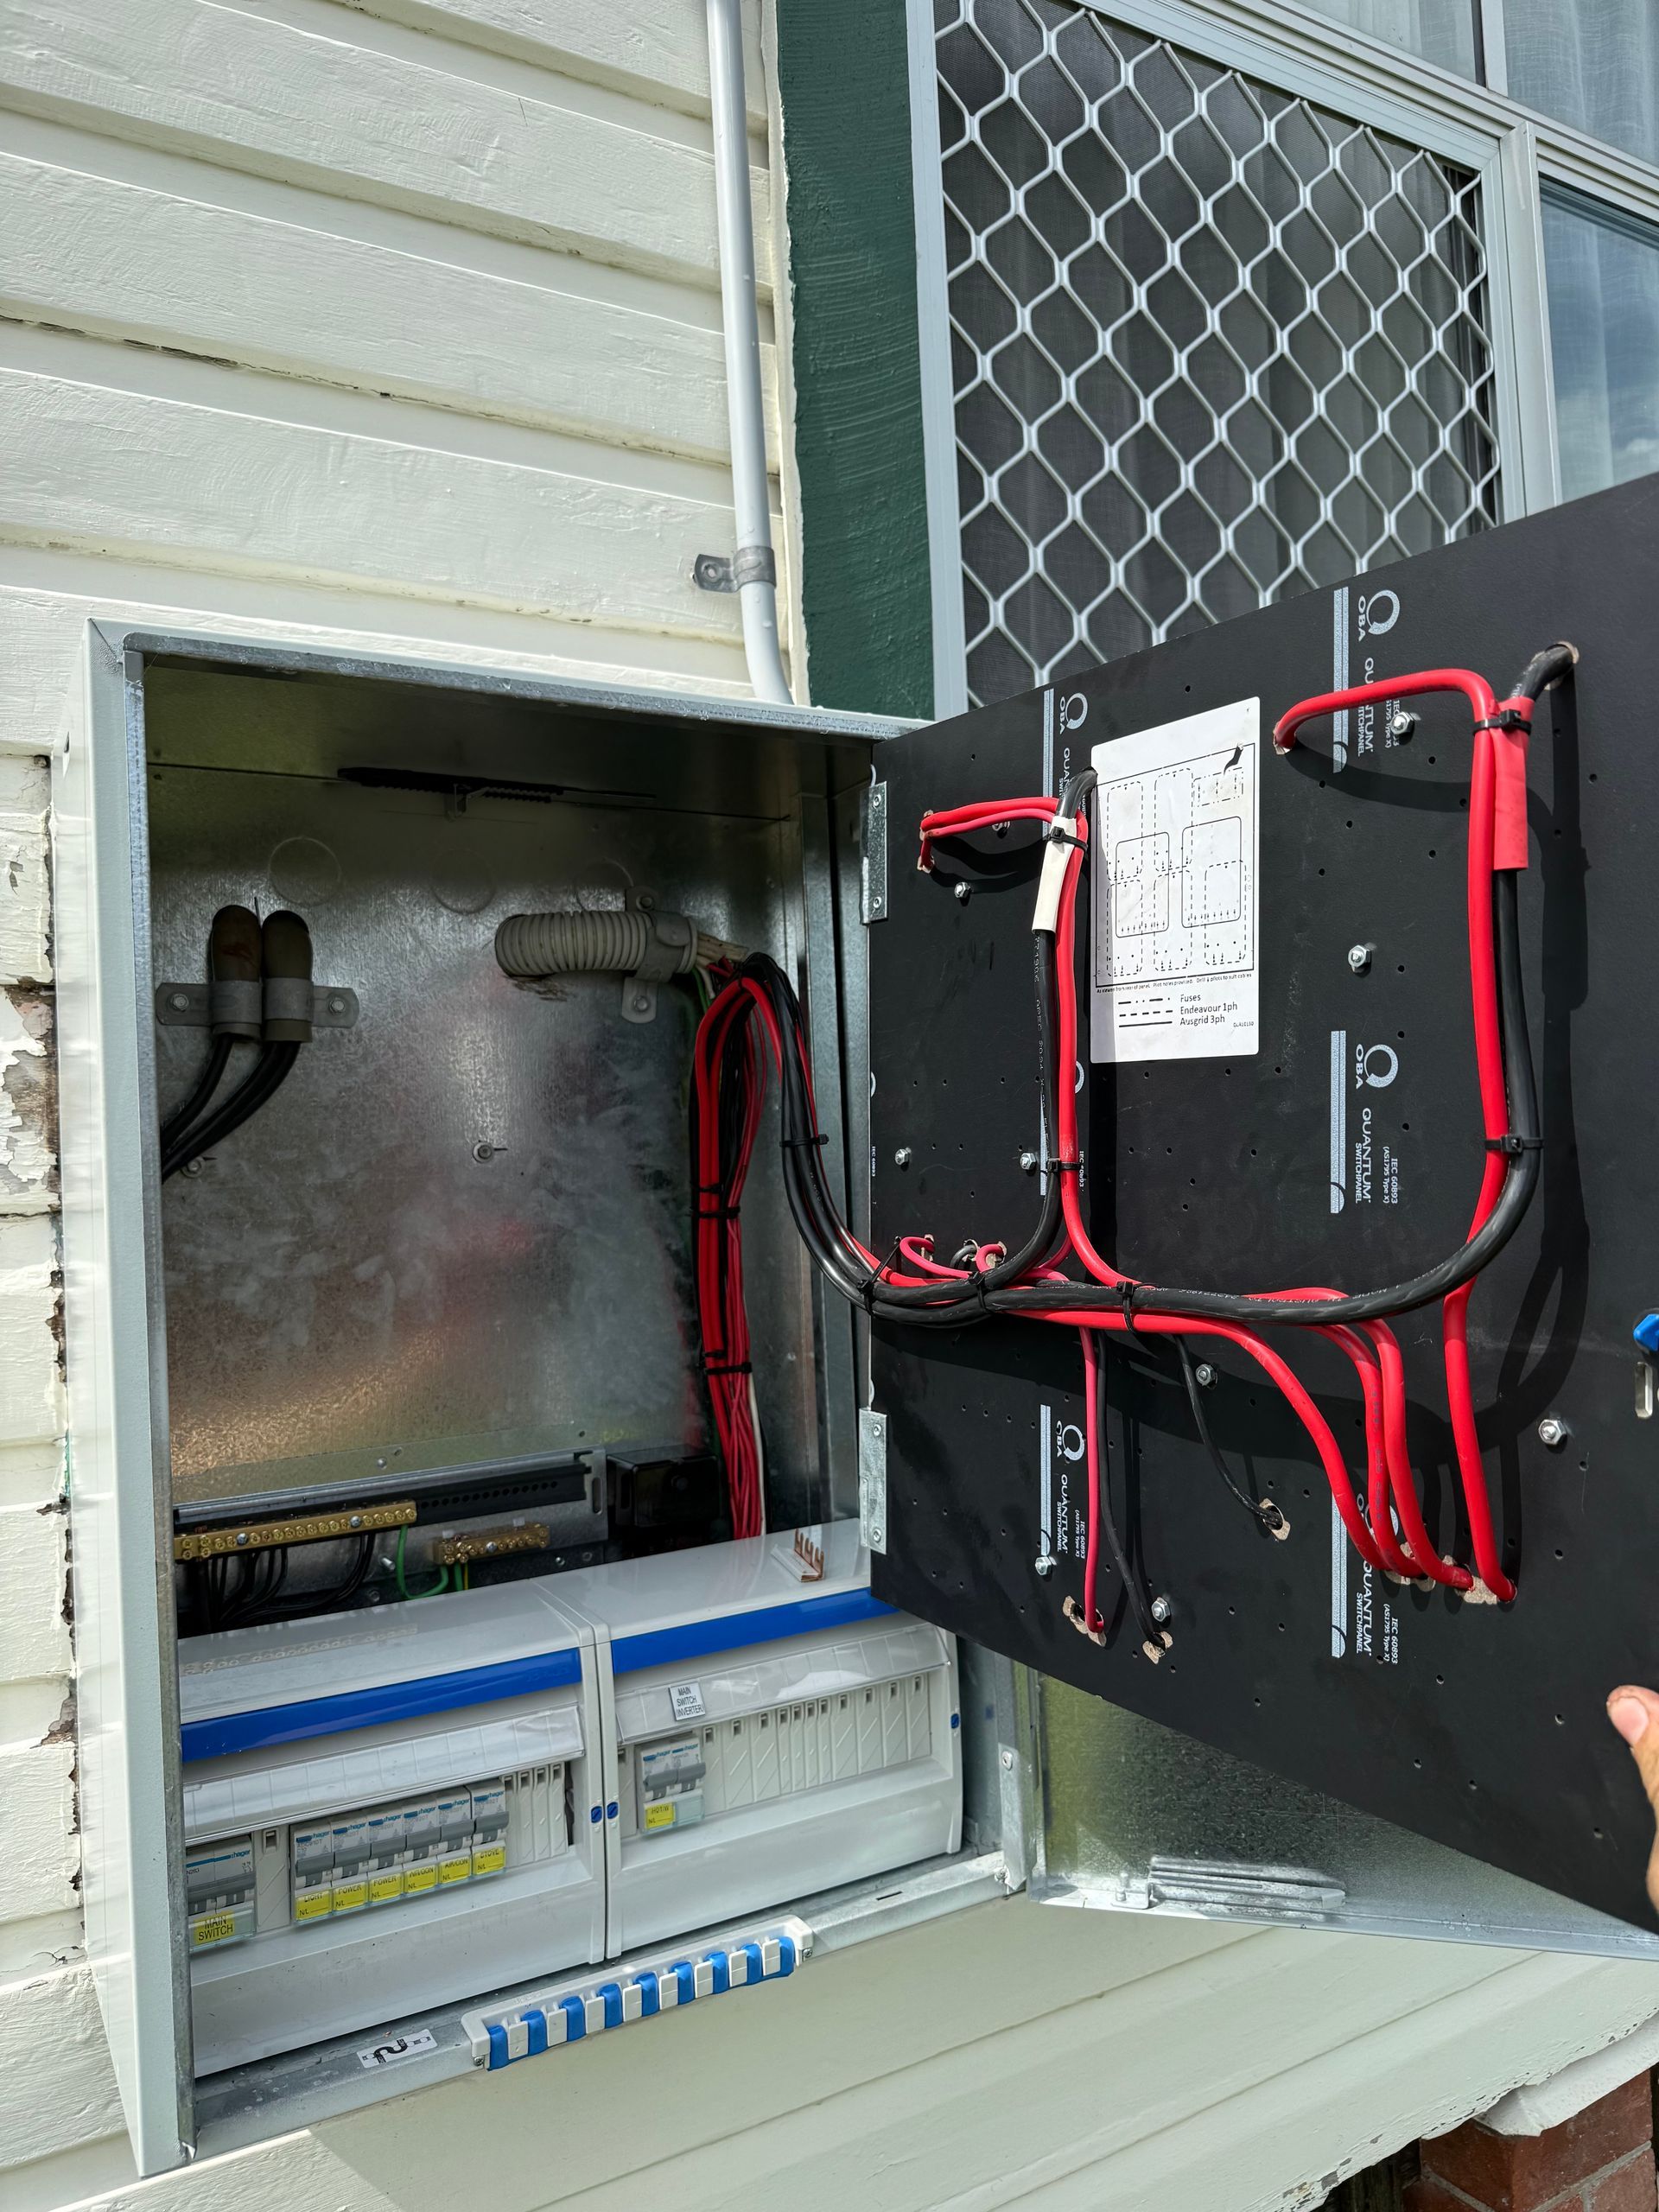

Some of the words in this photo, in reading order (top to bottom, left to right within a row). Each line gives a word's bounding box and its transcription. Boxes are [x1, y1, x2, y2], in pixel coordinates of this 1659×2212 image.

[1357, 595, 1366, 642] OBA
[1364, 658, 1374, 750] QUNTUM
[1180, 994, 1201, 1003] Fuses
[1180, 1004, 1222, 1015] Endeavour
[1223, 1001, 1238, 1013] 1ph
[1179, 1015, 1209, 1027] Ausgrid
[1210, 1014, 1225, 1026] 3ph
[1355, 1044, 1364, 1090] OBA
[1362, 1107, 1371, 1201] QUANTUM
[1390, 1174, 1399, 1205] 60893
[678, 1686, 691, 1696] MAIN
[677, 1694, 697, 1707] SWITCH
[676, 1704, 704, 1717] (INVERTER)
[373, 1876, 397, 1886] POWER
[338, 1885, 362, 1894] POWER
[204, 1915, 227, 1929] MAIN
[199, 1924, 233, 1941] SWITCH
